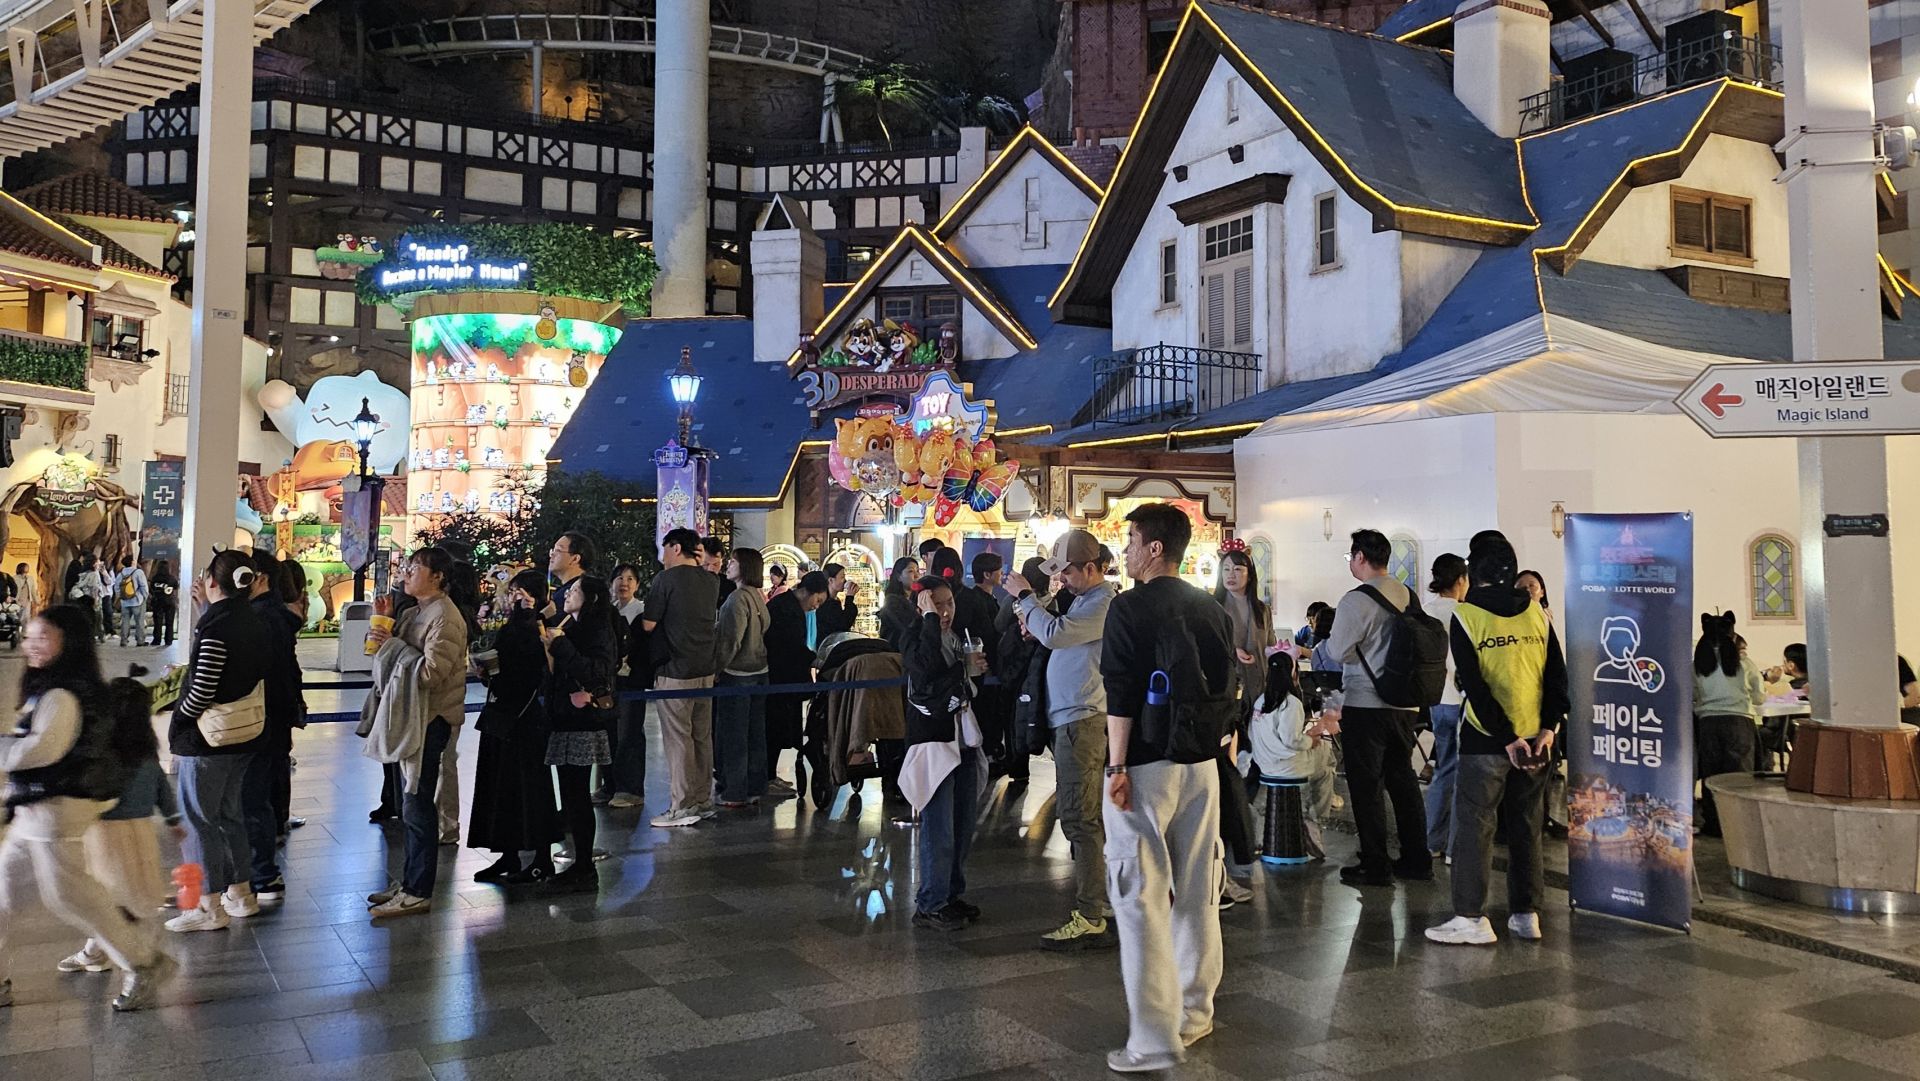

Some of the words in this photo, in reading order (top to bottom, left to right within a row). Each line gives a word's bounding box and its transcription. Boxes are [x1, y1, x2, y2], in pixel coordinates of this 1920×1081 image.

[797, 370, 840, 408] 3D
[1755, 375, 1890, 400] 매직아일랜드
[922, 392, 951, 416] TOY
[1777, 408, 1821, 423] Magic
[1826, 407, 1869, 420] Island
[152, 509, 174, 517] 의무실
[1592, 703, 1663, 734] 페이스
[1592, 734, 1662, 768] 페인팅
